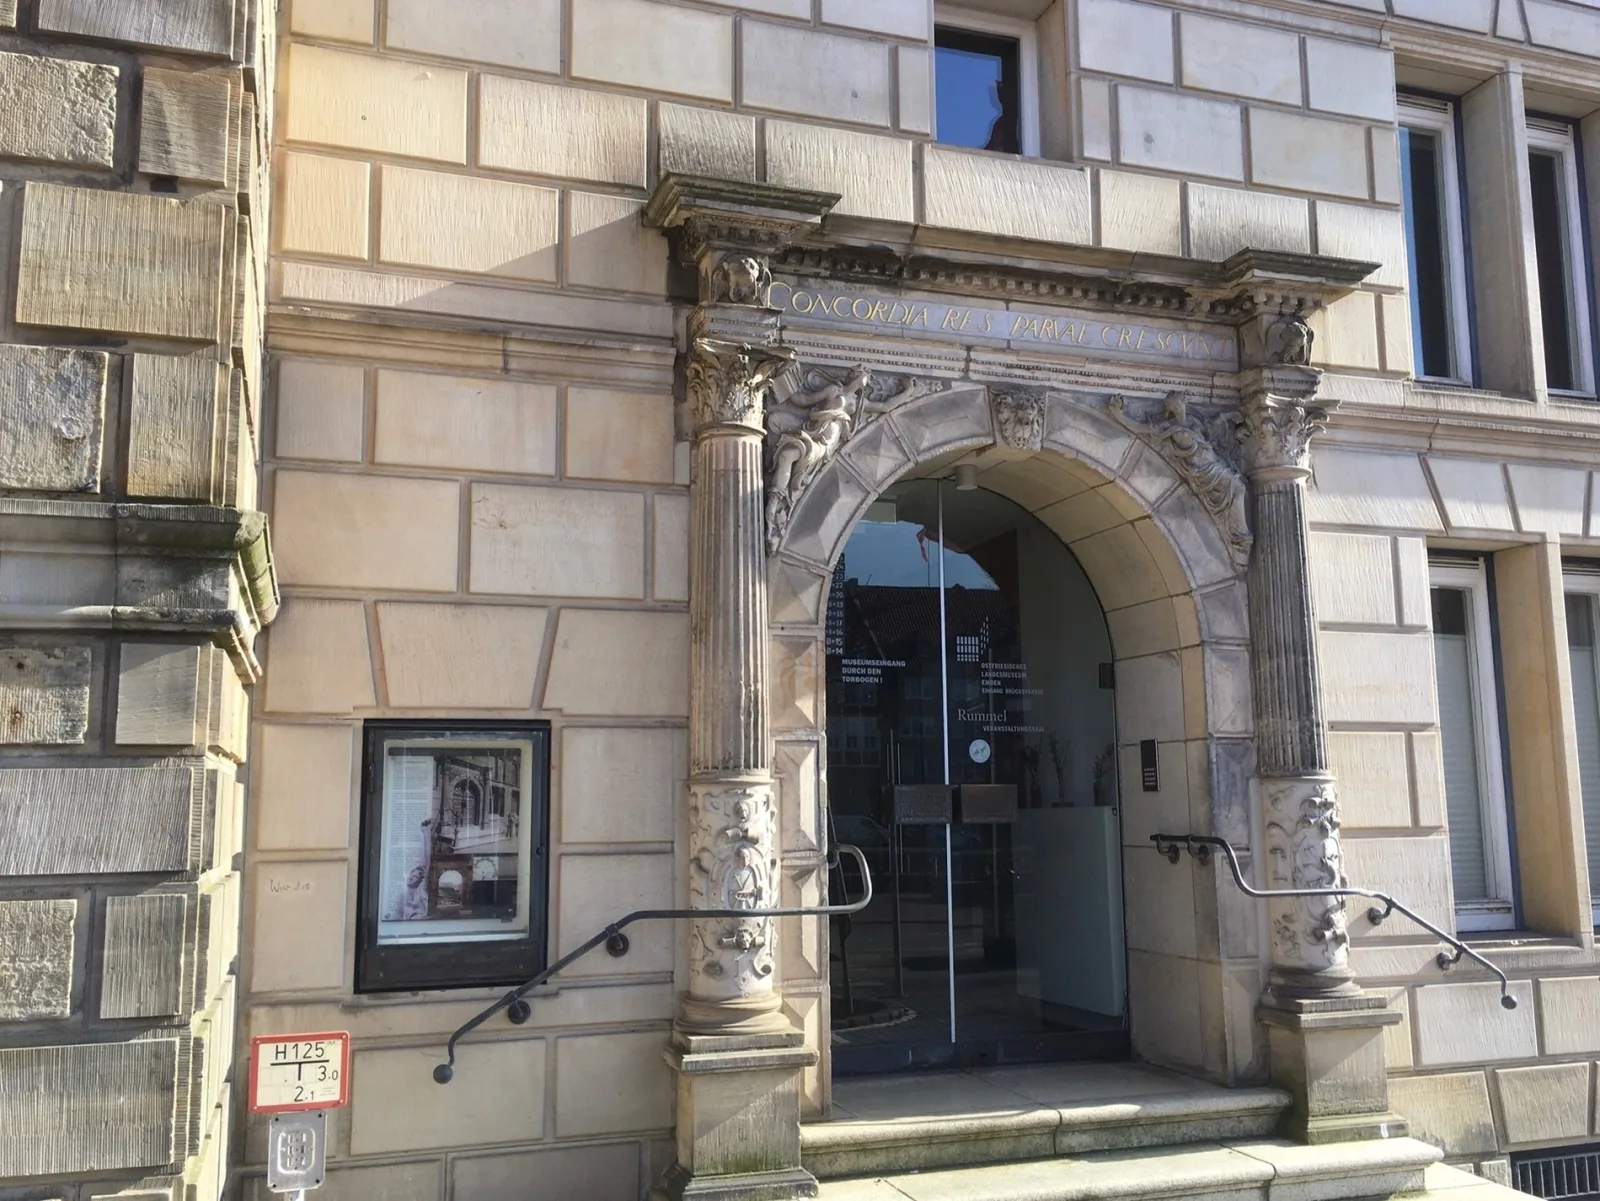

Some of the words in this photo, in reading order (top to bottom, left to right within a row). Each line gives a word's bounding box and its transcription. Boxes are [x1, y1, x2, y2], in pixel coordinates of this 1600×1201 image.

[769, 281, 928, 327] CONCORDIA
[941, 308, 992, 333] RES
[842, 658, 906, 667] MUSEUMSEINGANG
[981, 662, 1027, 670] OSTFRIESISCHES
[842, 667, 866, 675] DURCH
[981, 671, 1028, 679] LANDESMUSEUM
[842, 676, 879, 684] TORBOGEN
[957, 708, 1007, 722] Rummel
